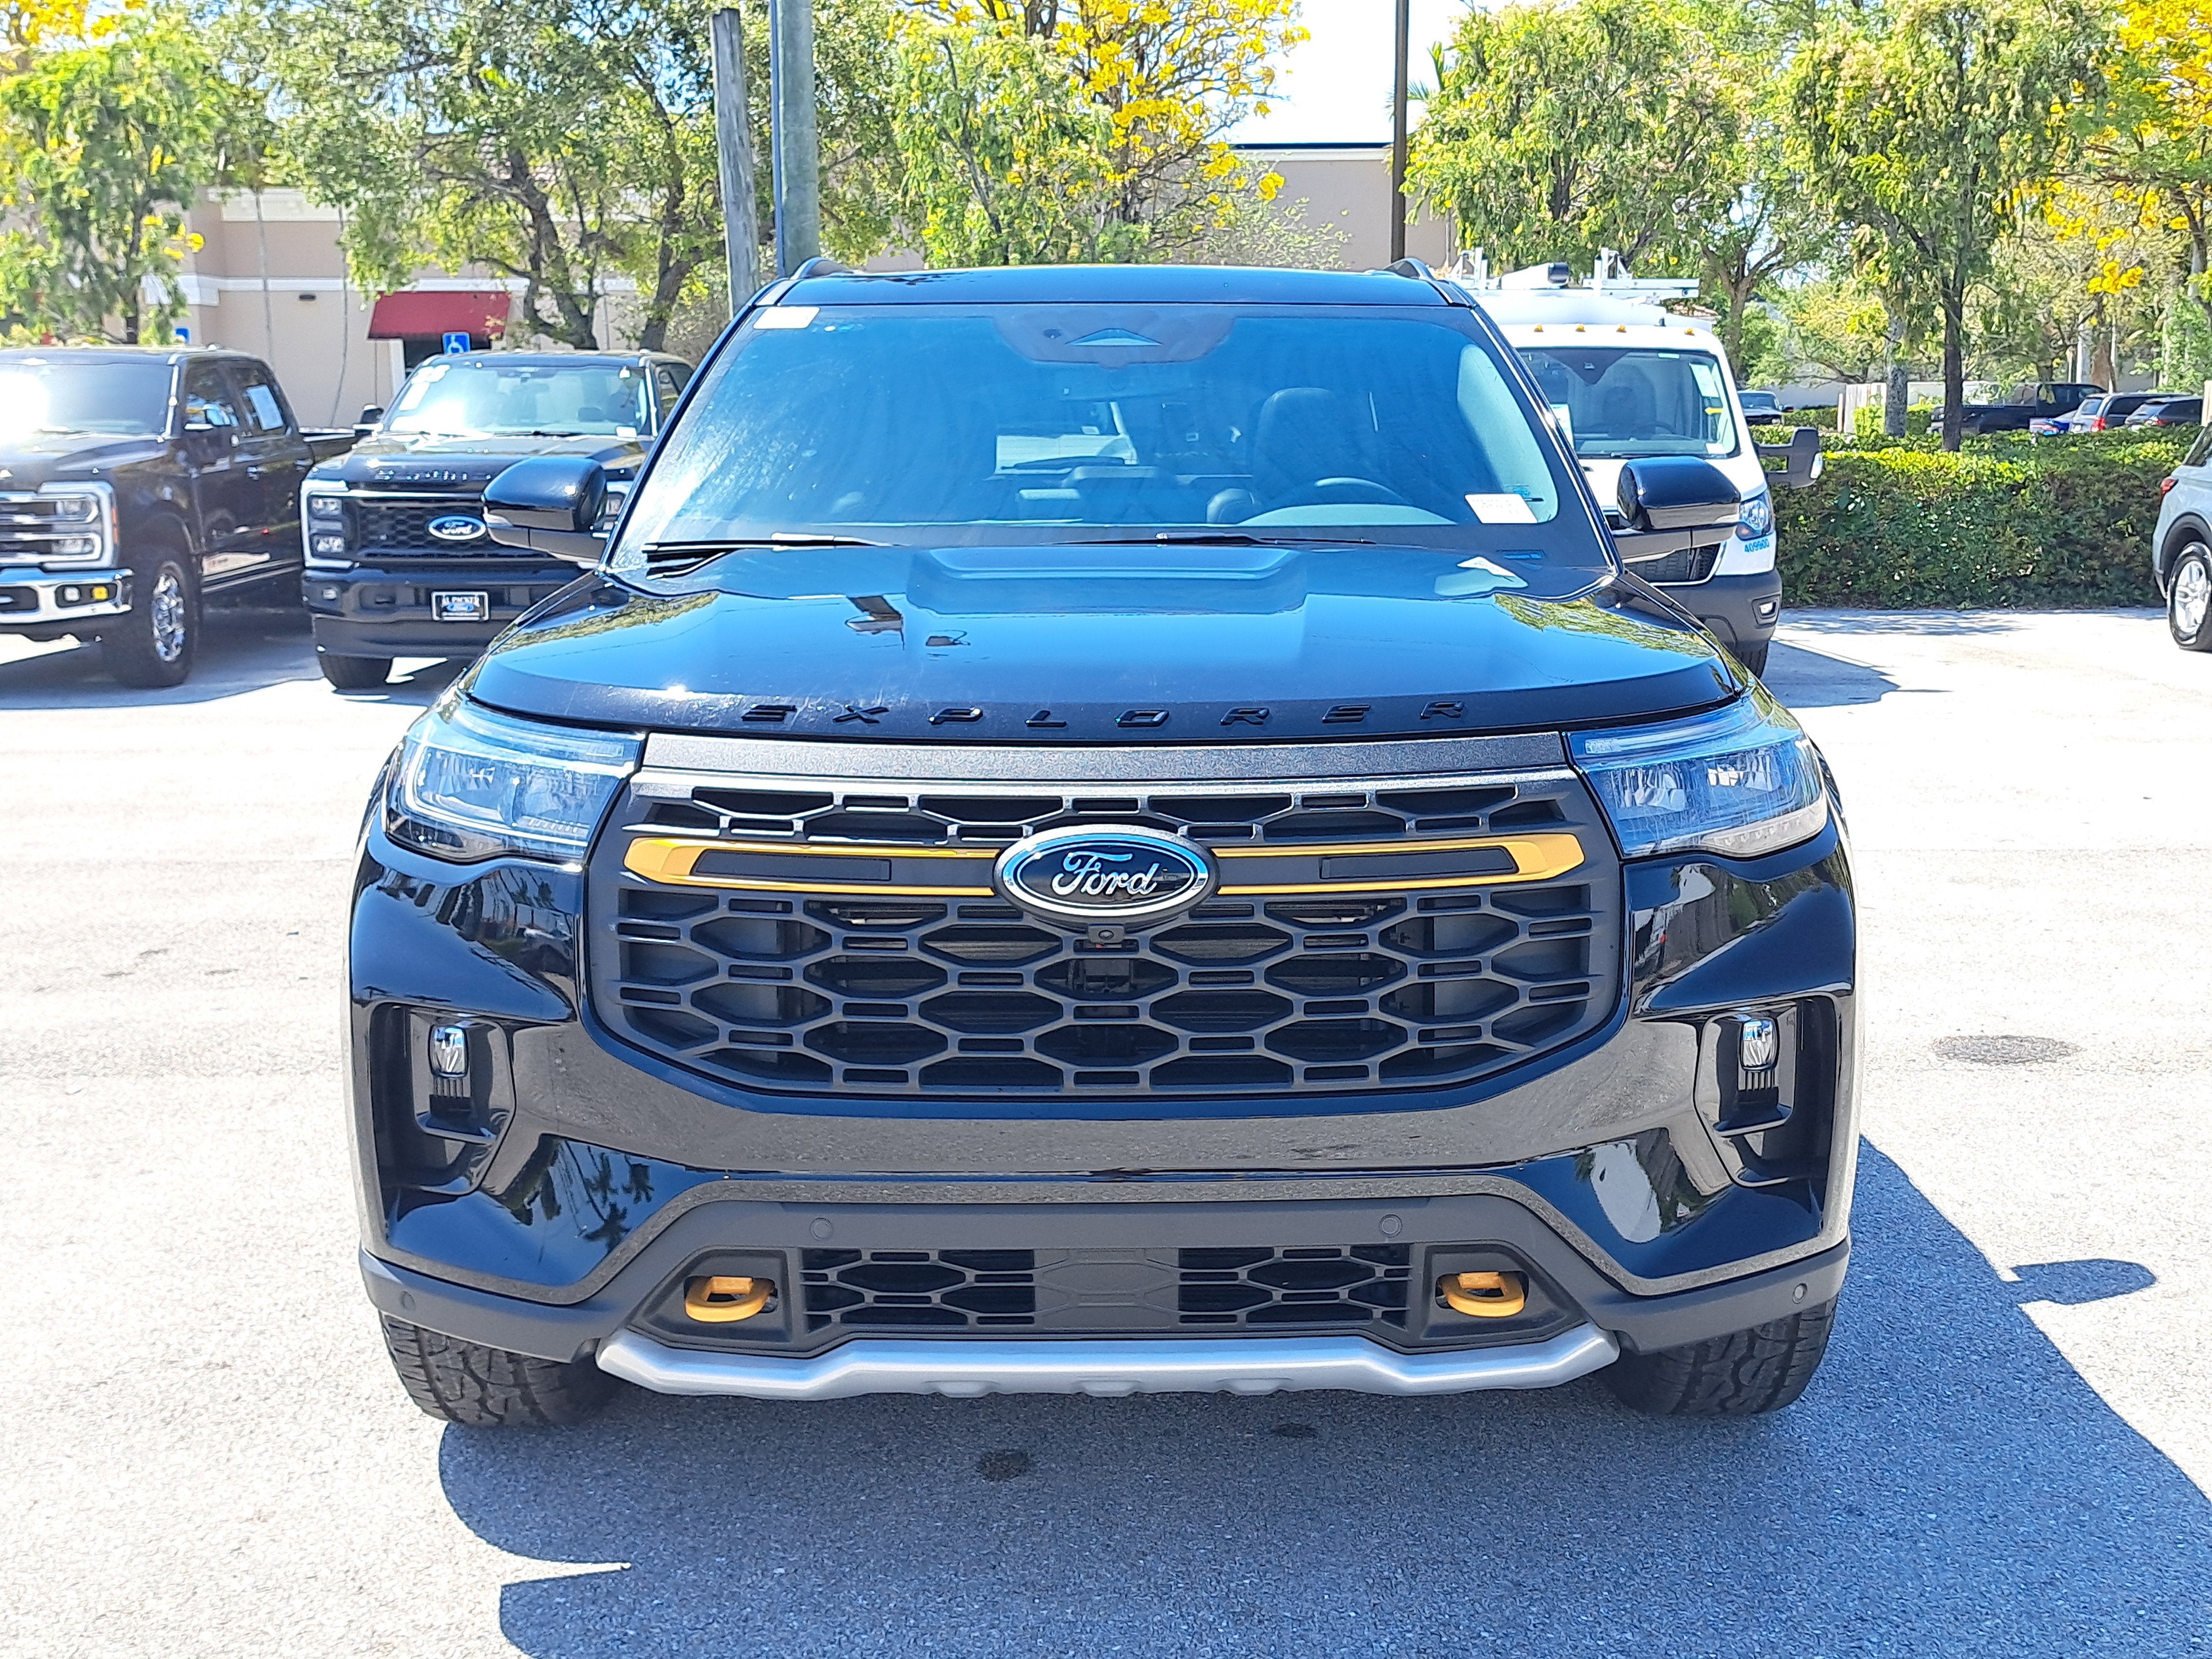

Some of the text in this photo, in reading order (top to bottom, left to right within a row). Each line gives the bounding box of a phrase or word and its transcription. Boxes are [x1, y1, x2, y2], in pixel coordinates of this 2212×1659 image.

[442, 520, 473, 534] Ford
[741, 700, 1466, 728] EXPLORER
[1051, 852, 1160, 896] Ford
